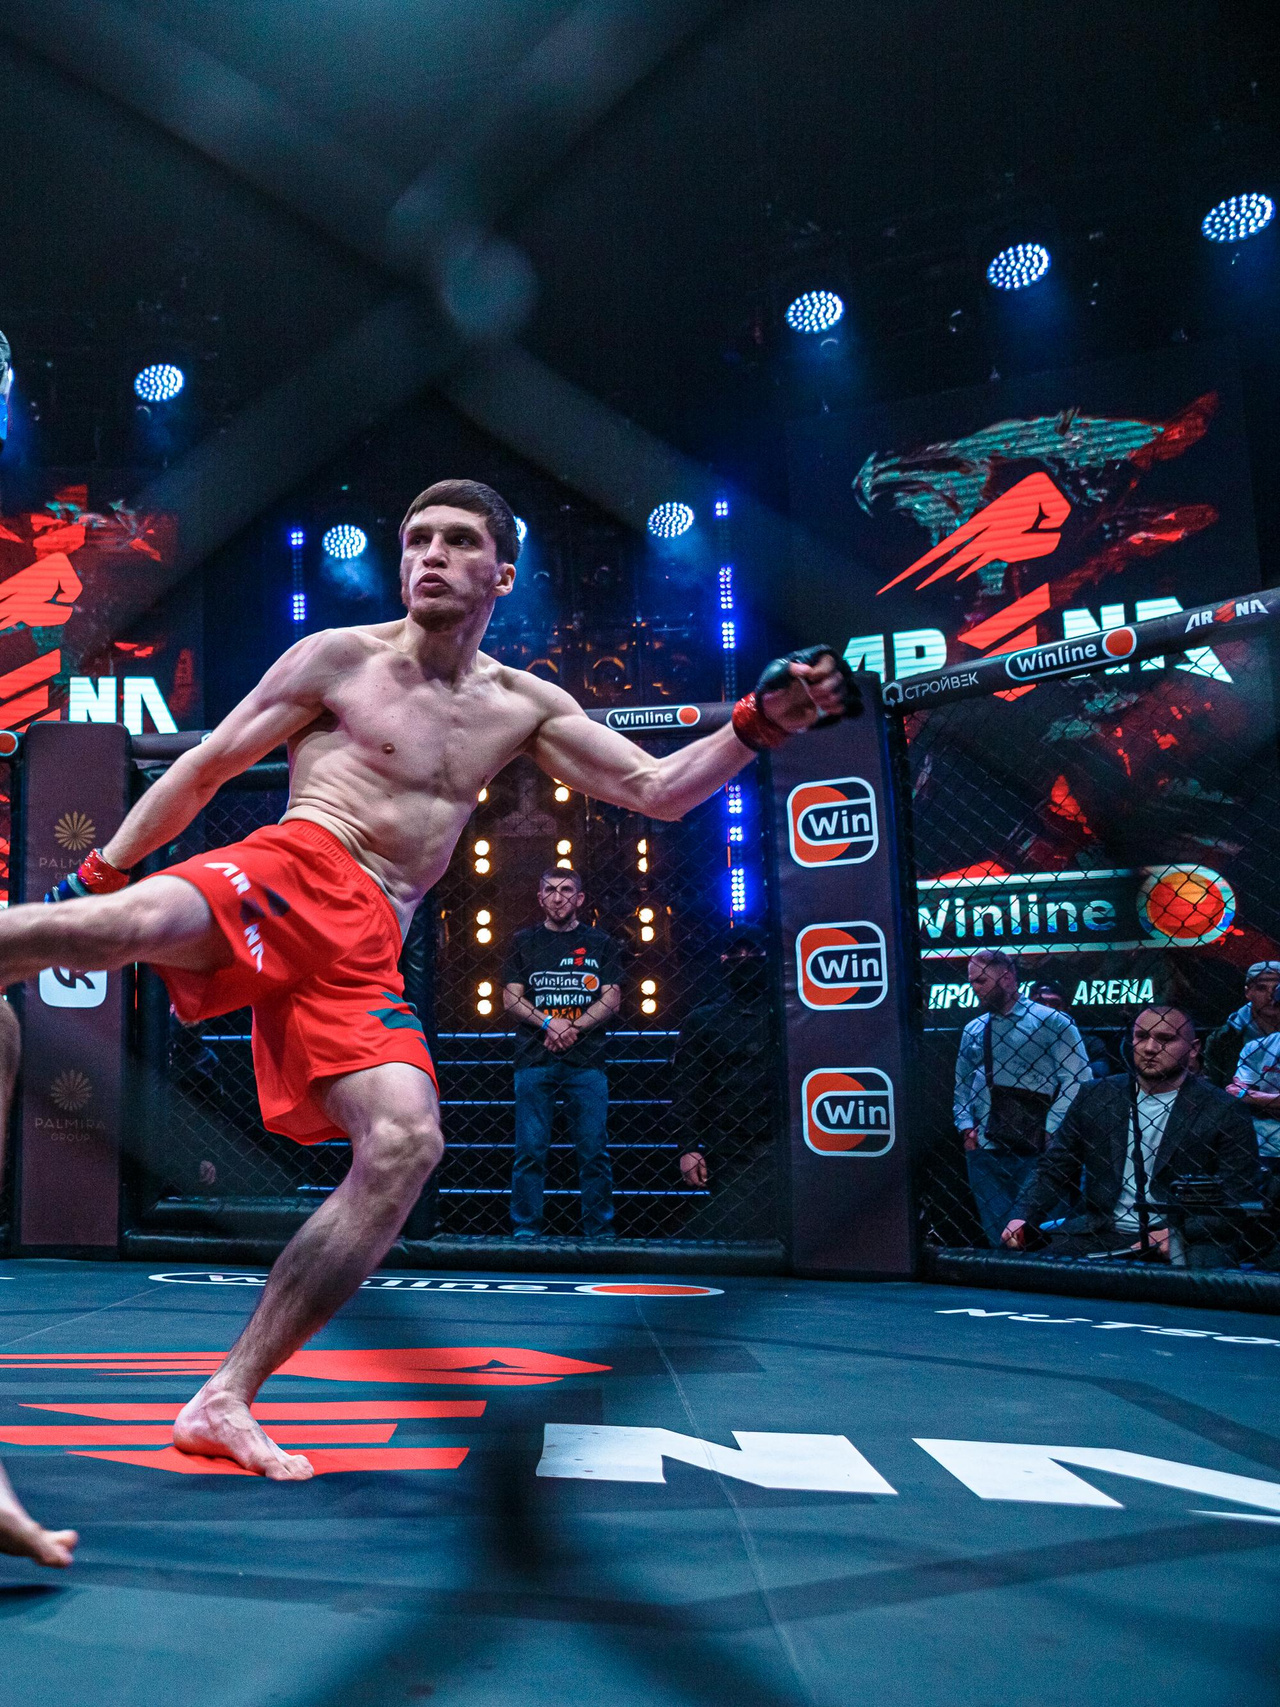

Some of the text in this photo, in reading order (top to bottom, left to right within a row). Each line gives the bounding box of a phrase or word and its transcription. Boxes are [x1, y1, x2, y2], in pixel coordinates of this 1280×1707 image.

[1017, 642, 1098, 674] Winline
[905, 672, 980, 700] СТРОЙВЕК
[614, 711, 674, 726] Winline
[808, 809, 870, 837] Win
[39, 857, 82, 869] PALM
[918, 893, 1117, 938] Winline
[818, 954, 880, 979] Win
[533, 976, 579, 987] Winline
[1071, 979, 1155, 1006] ARENA
[35, 1117, 106, 1129] PALMIRA
[824, 1100, 888, 1125] Win
[208, 1274, 549, 1291] Wline
